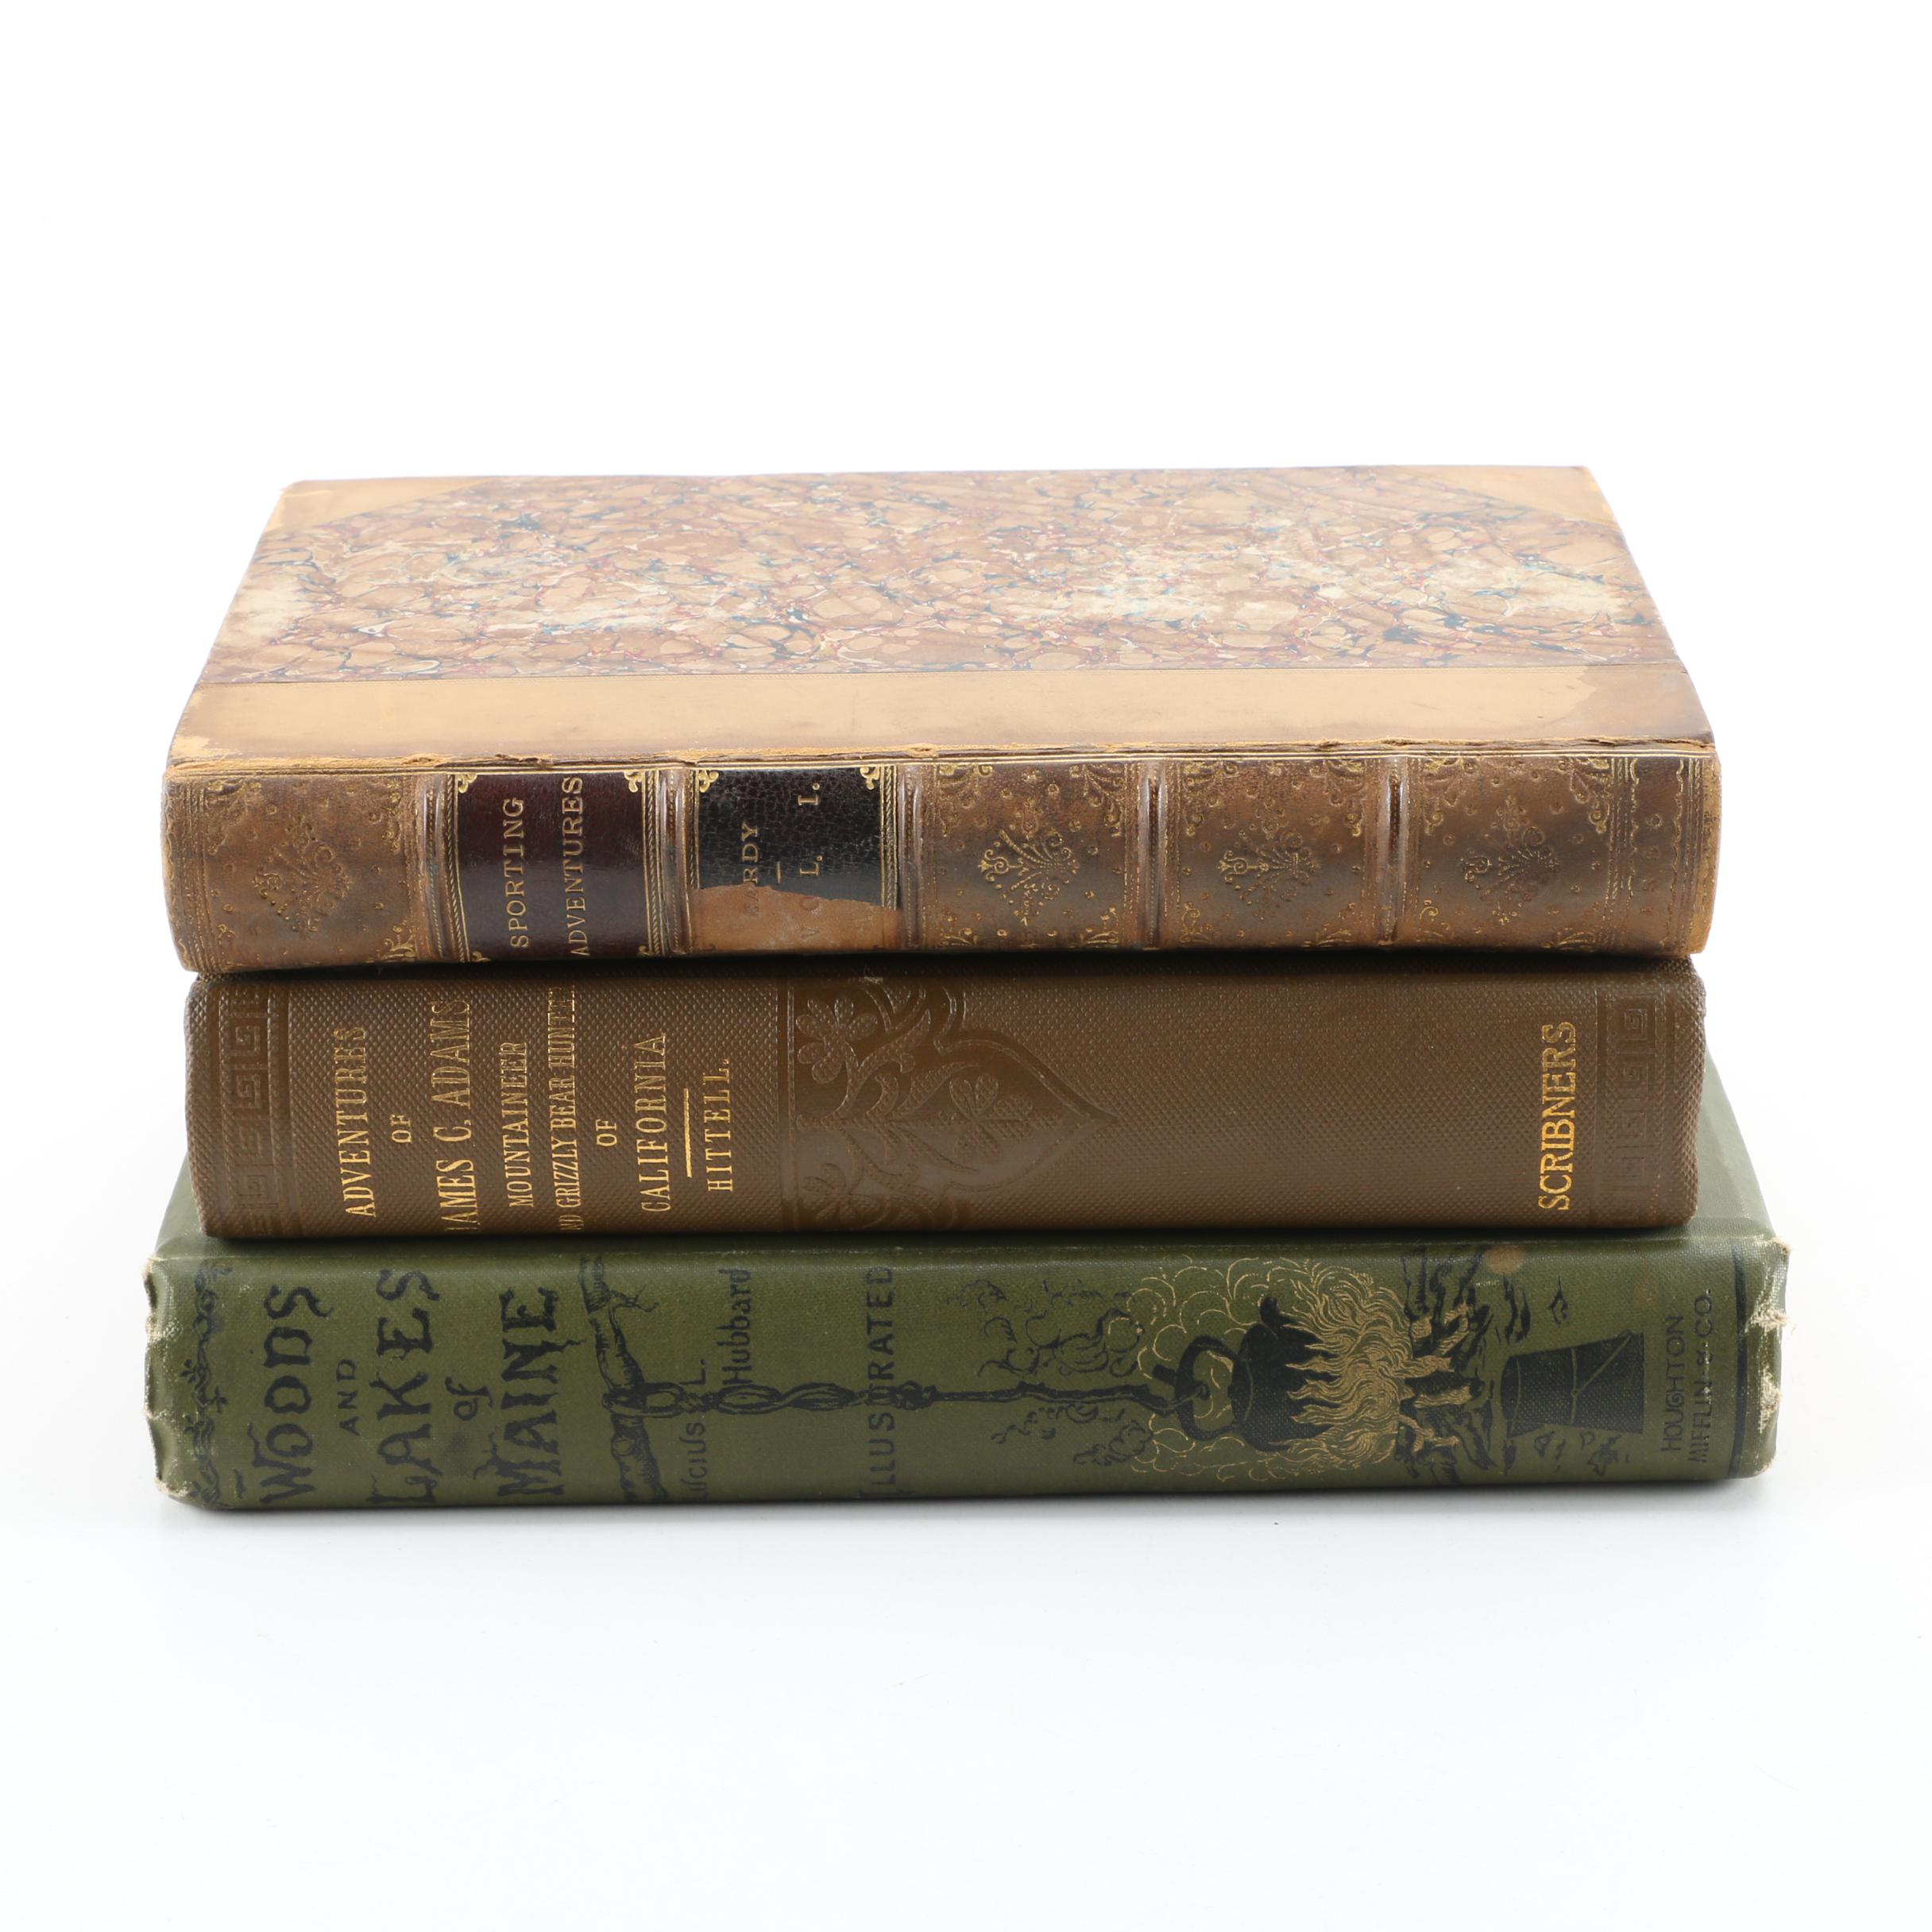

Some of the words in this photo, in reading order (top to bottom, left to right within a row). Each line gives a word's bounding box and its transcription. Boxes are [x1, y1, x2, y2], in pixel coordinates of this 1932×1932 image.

[503, 798, 529, 949] SPORTING
[562, 776, 589, 956] ADVENTURES
[430, 999, 471, 1108] ADAMS
[548, 1076, 577, 1131] BEAR
[1538, 1021, 1577, 1211] SCRIBNERS
[334, 1026, 377, 1218] ADVENTURES
[390, 1114, 412, 1143] OF
[433, 1119, 472, 1143] C.
[500, 1041, 534, 1208] MOUNTAINEER
[551, 1134, 582, 1210] GRIZZLY
[596, 1119, 617, 1146] OF
[635, 1033, 671, 1213] CALIFORNIA
[702, 1058, 733, 1192] HITTELL.
[559, 1213, 584, 1232] ND
[366, 1269, 442, 1504] LAKES
[483, 1286, 574, 1497] MAINE
[679, 1358, 707, 1385] L.
[717, 1268, 752, 1385] Hubbard
[1661, 1316, 1687, 1453] HOUGHTON
[246, 1285, 334, 1504] WOODS
[335, 1358, 360, 1436] AND
